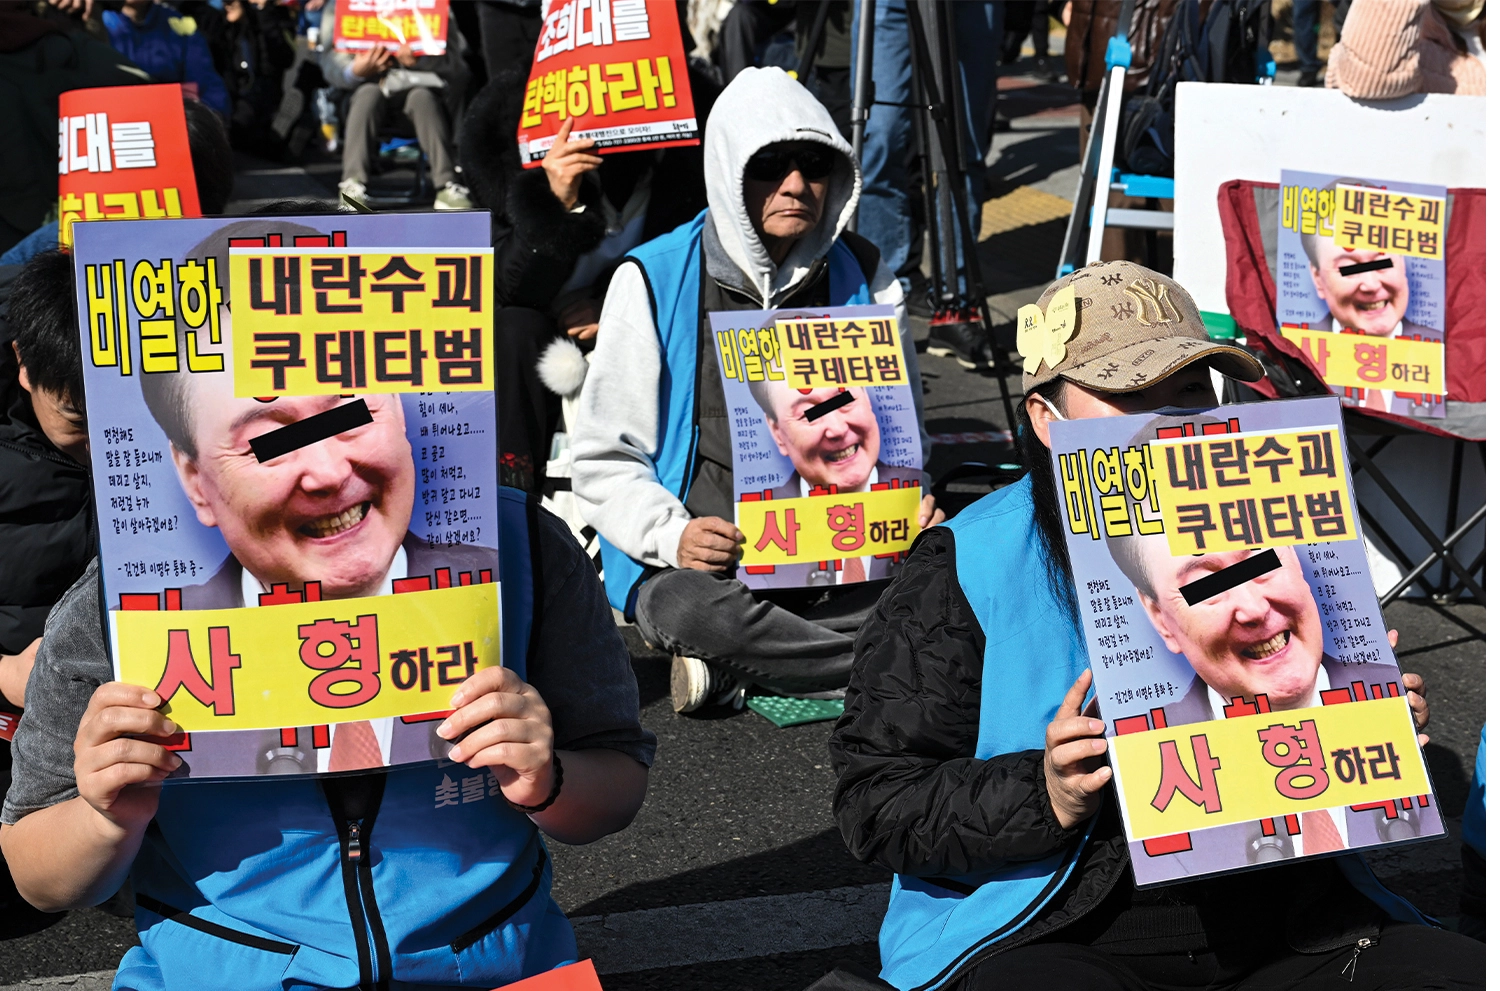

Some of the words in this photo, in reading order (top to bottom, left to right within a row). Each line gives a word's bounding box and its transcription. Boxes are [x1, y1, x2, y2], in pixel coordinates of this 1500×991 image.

[521, 55, 677, 129] 탄핵하라!
[1281, 185, 1336, 237] 비열한
[1343, 189, 1440, 225] 내란수괴
[1342, 220, 1438, 255] 쿠데타범
[248, 255, 483, 316] 내란수괴
[85, 257, 225, 376] 비열한
[785, 319, 895, 350] 내란수괴
[250, 328, 483, 391] 쿠데타범
[717, 327, 785, 383] 비열한
[793, 354, 901, 385] 쿠데타범
[418, 401, 435, 418] 힘이
[104, 427, 134, 444] 멍청해도
[420, 426, 429, 437] 배
[105, 450, 121, 467] 말을
[123, 450, 131, 467] 잘
[134, 449, 162, 467] 들으니까
[421, 447, 428, 460] 코
[431, 445, 445, 462] 골고
[1165, 431, 1337, 491] 내란수괴
[108, 475, 130, 487] 데리고
[421, 468, 437, 484] 많이
[110, 495, 133, 511] 저런걸
[135, 496, 150, 511] 누가
[422, 489, 438, 505] 방귀
[441, 487, 455, 504] 달고
[459, 487, 481, 500] 다니고
[1059, 444, 1165, 541] 비열한
[113, 517, 128, 534] 같이
[425, 510, 441, 526] 당신
[1175, 490, 1347, 550] 쿠데타범
[426, 532, 442, 549] 같이
[124, 561, 147, 577] 김건희
[150, 560, 170, 577] 이명수
[173, 560, 187, 577] 통화
[190, 560, 197, 577] 중
